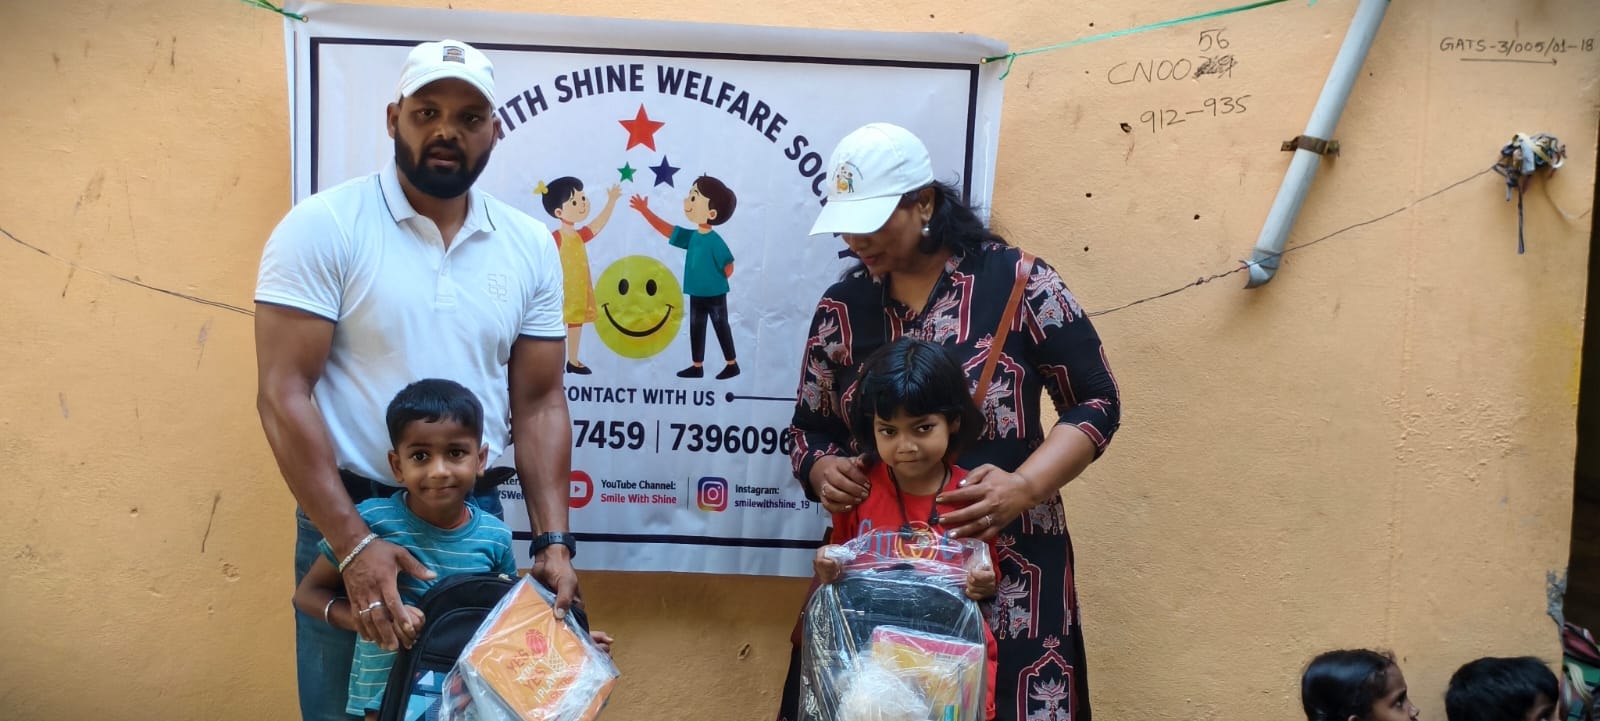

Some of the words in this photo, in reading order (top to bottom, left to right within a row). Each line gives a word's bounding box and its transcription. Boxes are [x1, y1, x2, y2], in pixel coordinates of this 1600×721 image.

[1198, 28, 1230, 52] 56
[492, 84, 549, 140] ITH
[554, 64, 645, 103] SHINE
[657, 65, 788, 144] WELFARE
[784, 135, 829, 207] SOC
[564, 385, 637, 404] ONTACT
[643, 388, 687, 406] WITH
[693, 390, 715, 407] US
[601, 479, 637, 489] YouTube
[639, 480, 677, 490] Channel:
[735, 484, 780, 496] Instagram:
[600, 493, 626, 503] Smile
[628, 494, 650, 504] With
[652, 494, 677, 504] Shine
[734, 499, 810, 510] smilewithshine_19
